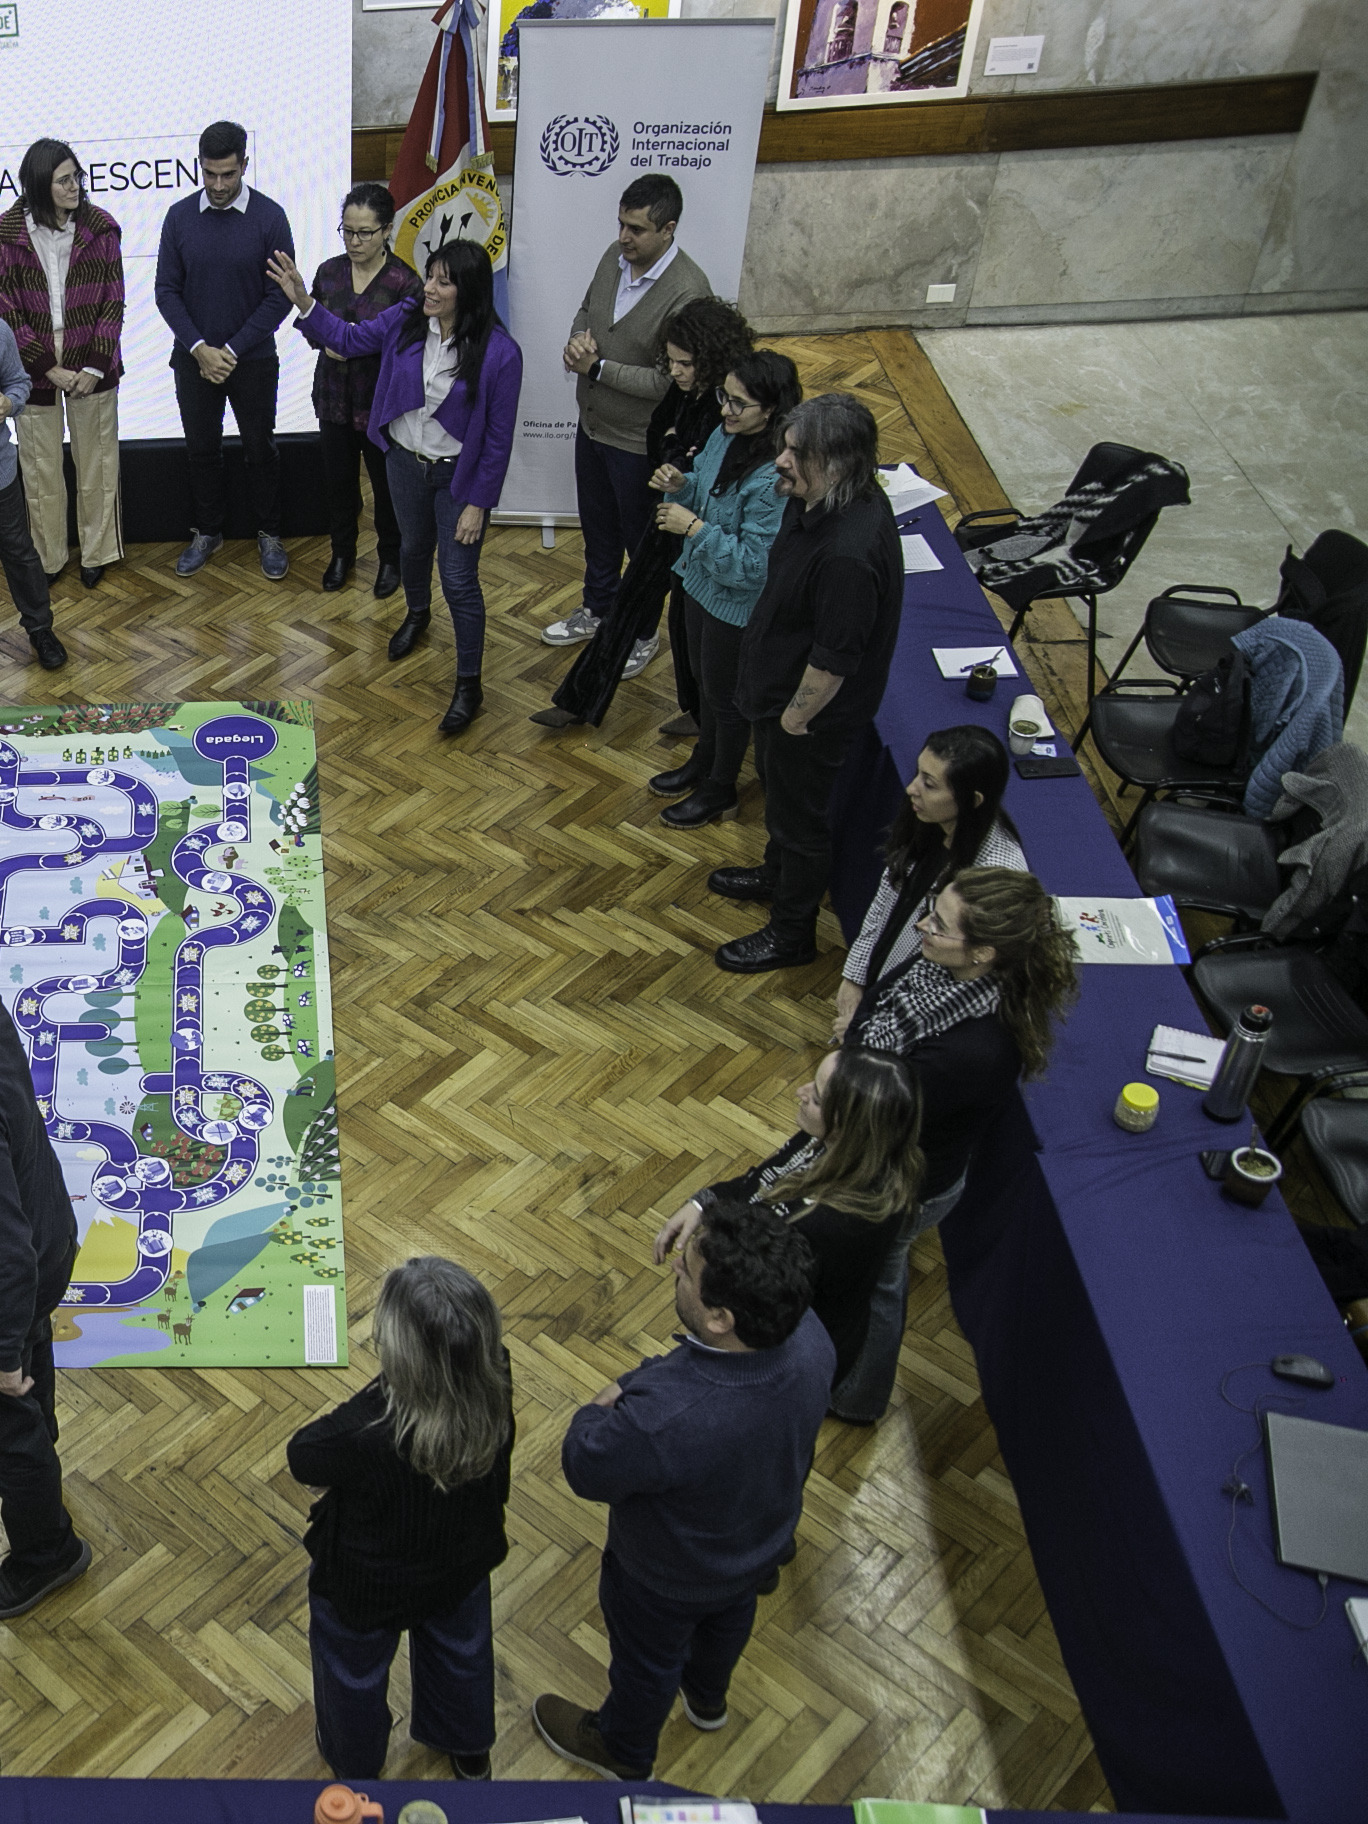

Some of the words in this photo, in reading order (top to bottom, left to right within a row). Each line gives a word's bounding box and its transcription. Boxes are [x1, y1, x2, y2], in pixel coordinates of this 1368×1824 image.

[633, 121, 732, 138] Organización
[560, 128, 598, 157] OIT
[632, 138, 730, 151] Internacional
[630, 154, 652, 167] del
[657, 154, 712, 170] Trabajo
[523, 420, 552, 428] Oficina
[205, 734, 264, 745] Llegada
